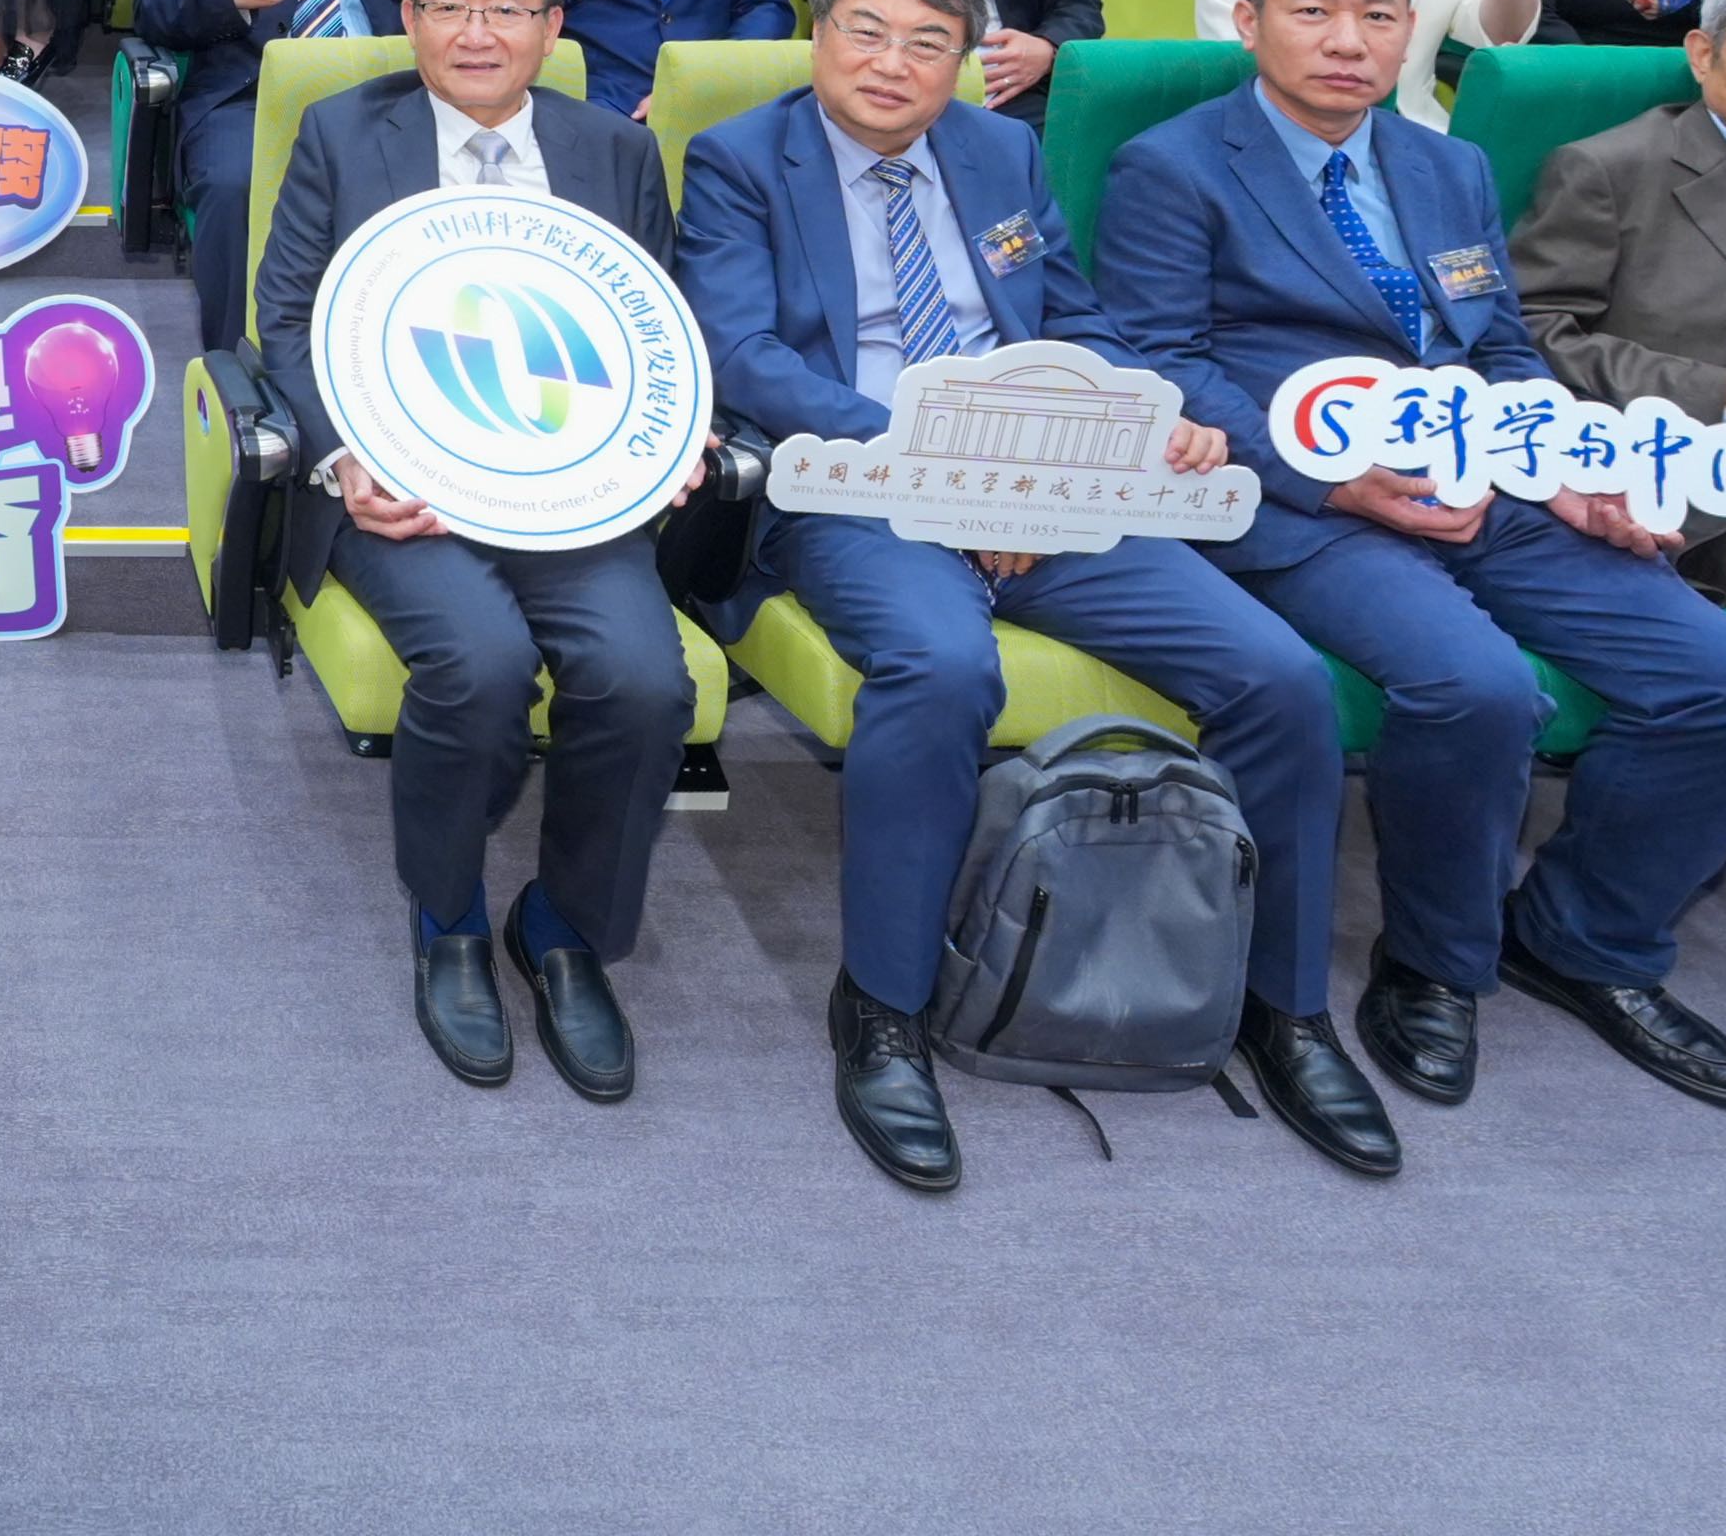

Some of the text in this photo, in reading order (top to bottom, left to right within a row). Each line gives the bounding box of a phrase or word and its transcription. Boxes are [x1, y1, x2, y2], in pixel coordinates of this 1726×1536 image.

[422, 210, 679, 458] 中国科学院科技创新发展中心
[349, 315, 366, 389] Technology
[361, 391, 411, 459] Innovation
[410, 453, 438, 480] and
[438, 474, 538, 513] Development
[816, 487, 895, 501] ANNIVERSARY
[896, 492, 912, 502] OF
[913, 494, 937, 504] THE
[938, 496, 997, 510] ACADEMIC
[1061, 505, 1106, 516] CHINESE
[1110, 507, 1164, 520] ACADEMY
[1165, 511, 1179, 521] OF
[1181, 512, 1234, 524] SCIENCES
[956, 518, 1060, 537] SINCE 1955
